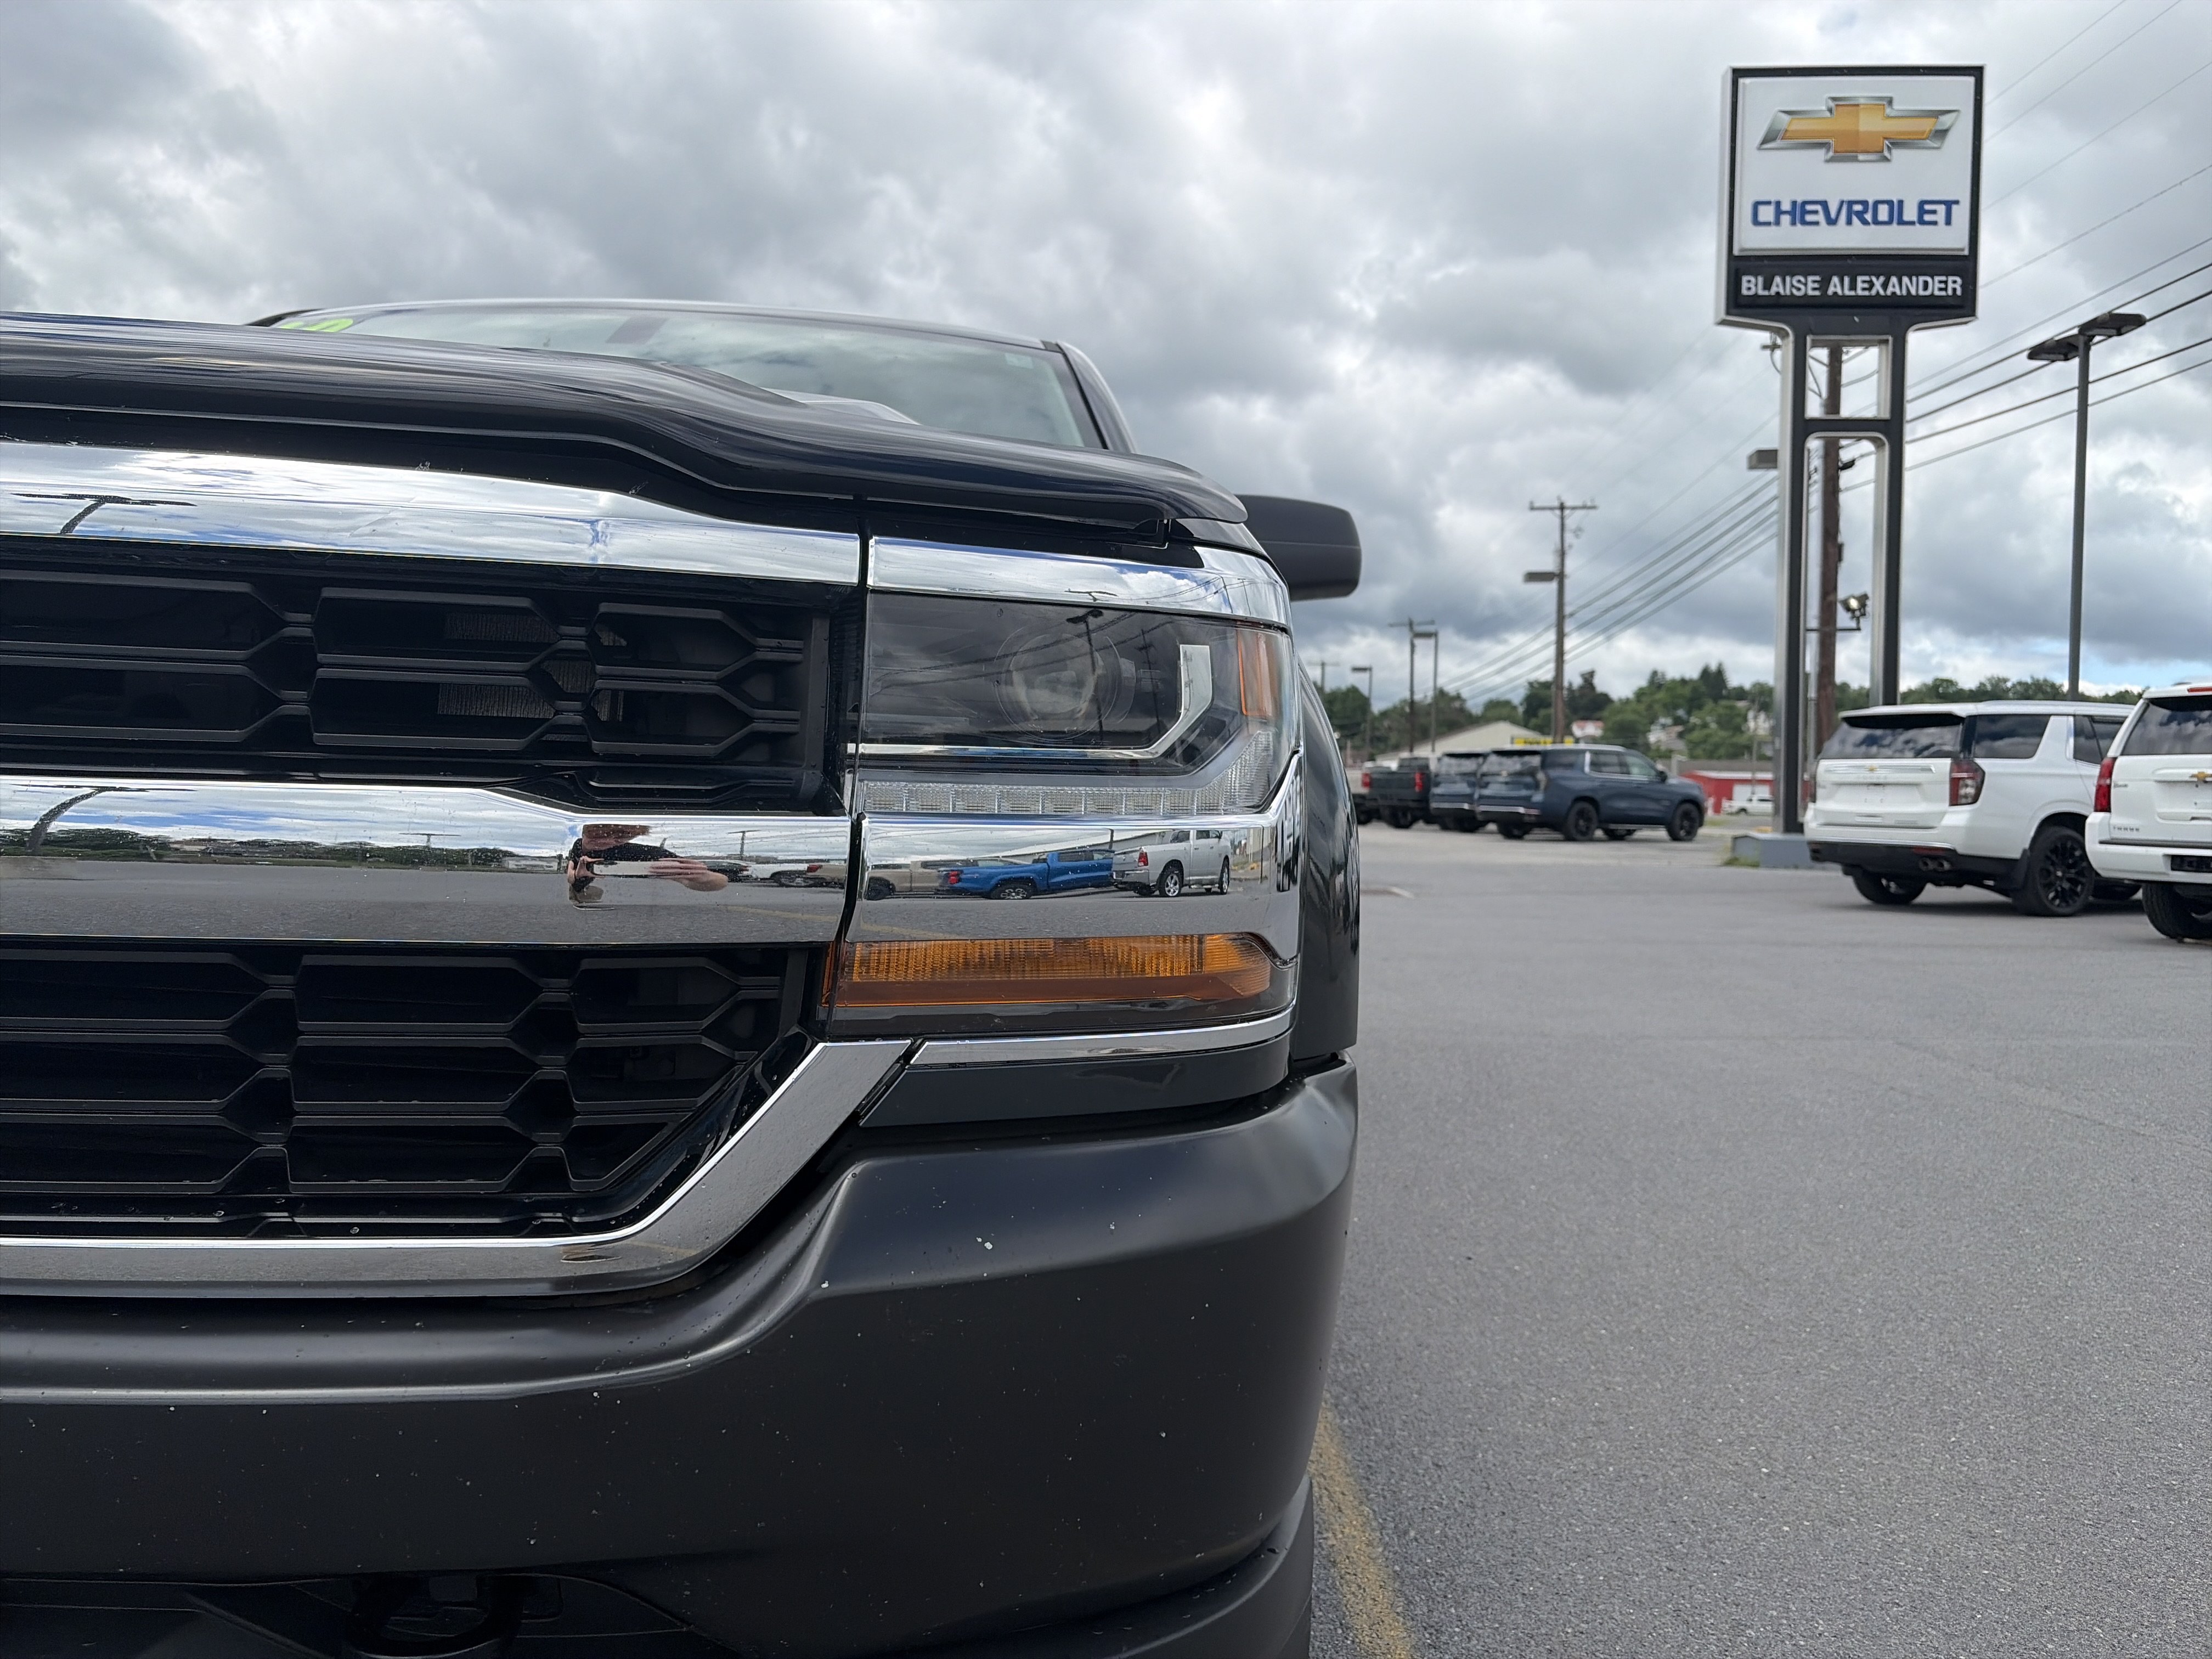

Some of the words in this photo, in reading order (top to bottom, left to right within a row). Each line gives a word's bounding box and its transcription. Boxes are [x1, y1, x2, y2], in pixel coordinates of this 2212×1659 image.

[1752, 199, 1960, 225] CHEVROLET
[1741, 275, 1821, 296] BLAISE
[1827, 275, 1962, 296] ALEXANDER
